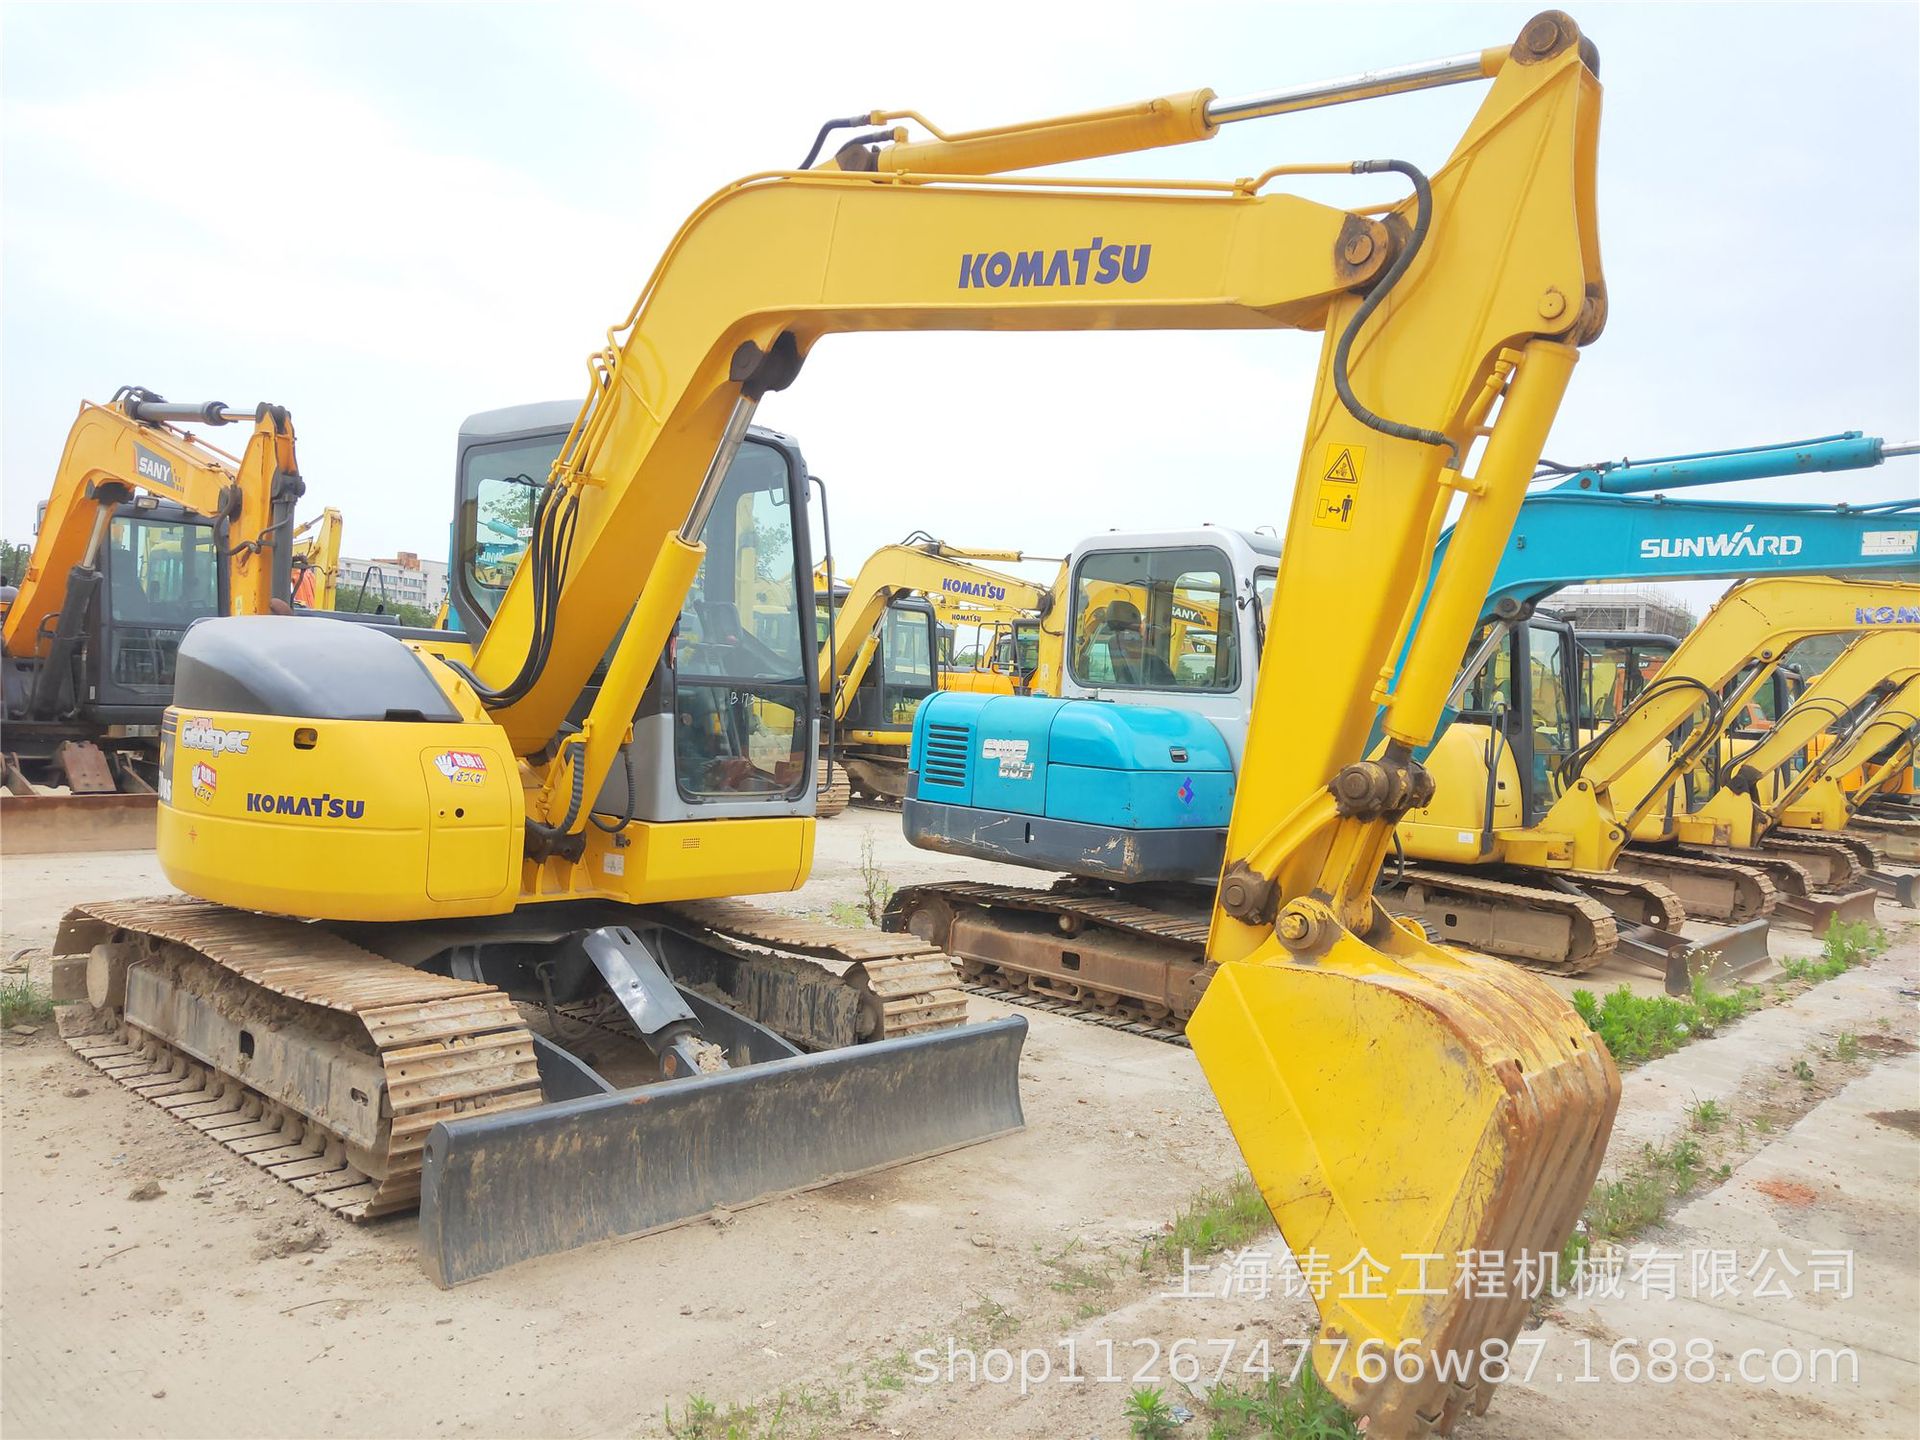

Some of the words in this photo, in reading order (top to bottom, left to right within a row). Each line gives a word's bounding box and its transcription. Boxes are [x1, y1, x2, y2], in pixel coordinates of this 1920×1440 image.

[958, 237, 1152, 288] KOMATSU
[139, 456, 171, 482] SANY
[1640, 524, 1803, 558] SUNWARD
[942, 578, 1006, 601] KOMATSU
[952, 613, 982, 623] KOMATSU
[247, 793, 365, 819] KOMATSU
